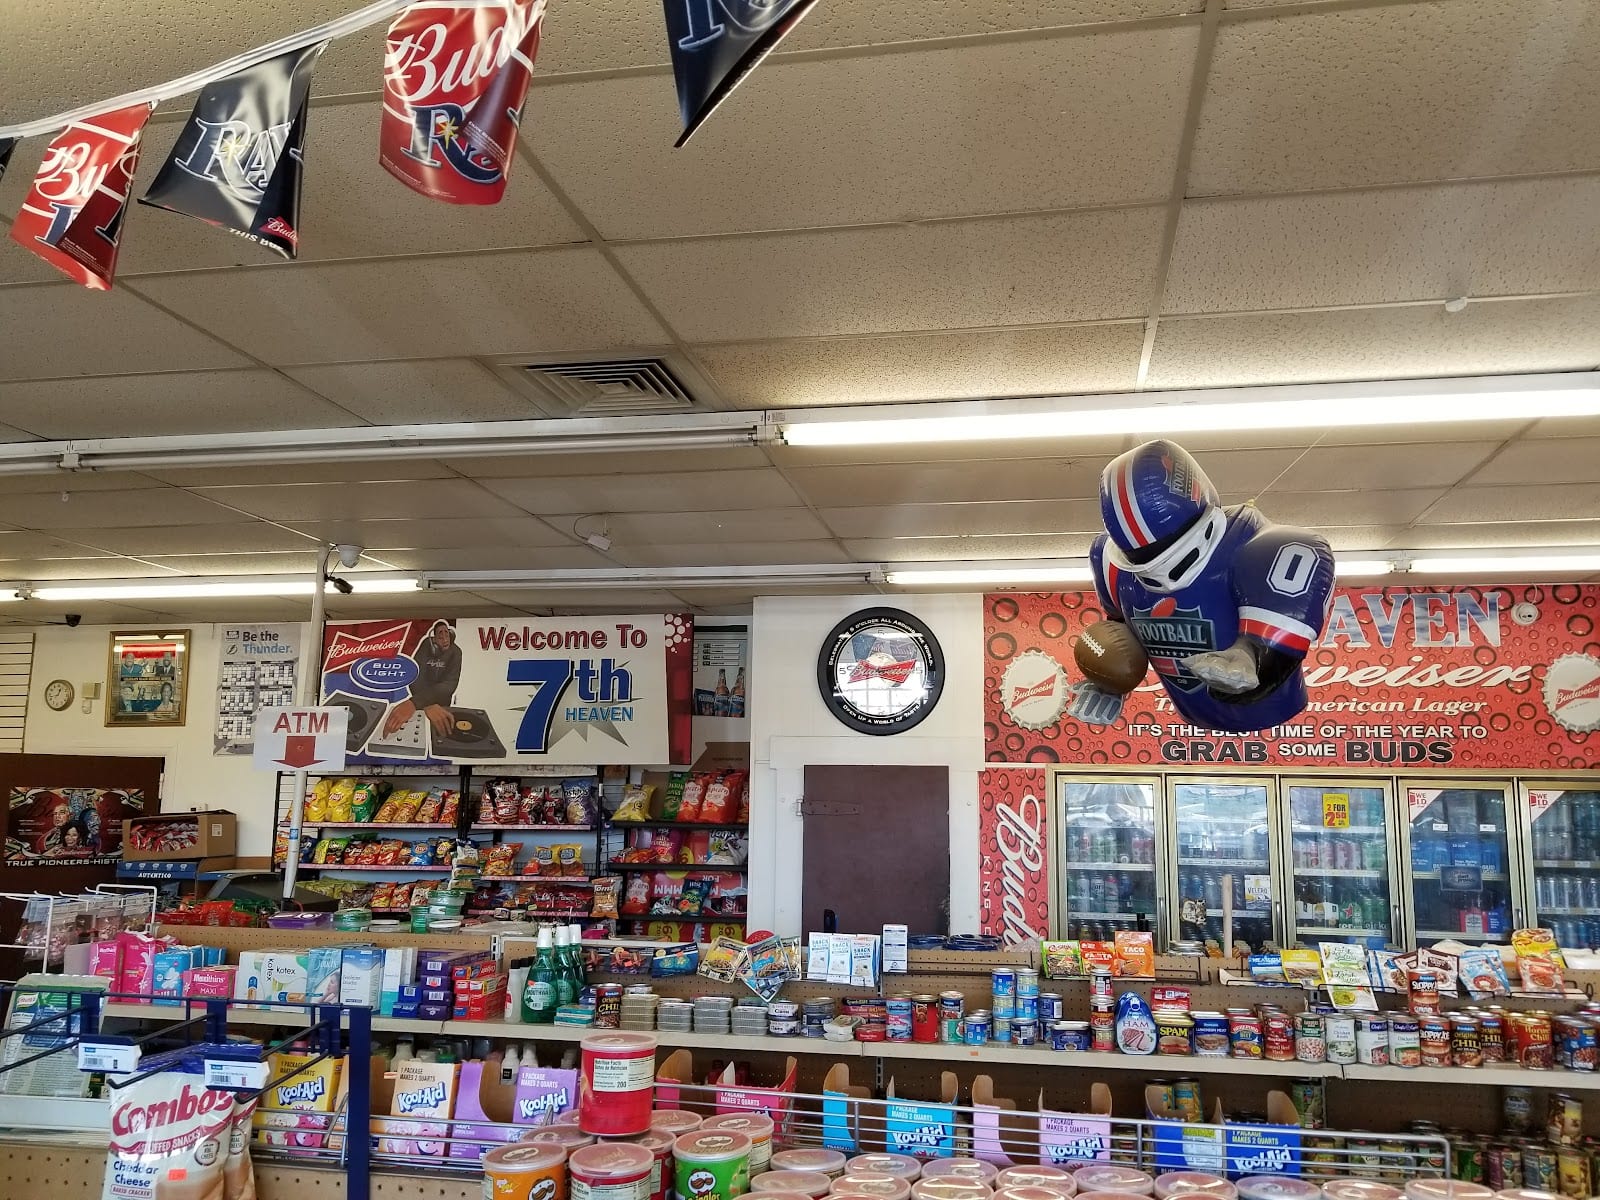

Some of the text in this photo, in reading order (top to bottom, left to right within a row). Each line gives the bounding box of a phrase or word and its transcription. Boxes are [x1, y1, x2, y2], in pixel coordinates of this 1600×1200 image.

[1312, 592, 1501, 649] AVEN
[242, 631, 257, 641] Be
[260, 630, 279, 641] the
[478, 624, 647, 651] Welcome To
[1138, 622, 1207, 644] FOOTBALL
[242, 643, 293, 654] Thunder.
[327, 639, 404, 659] Budweiser
[1301, 655, 1532, 688] weiser
[506, 659, 633, 754] 7th
[1306, 697, 1488, 715] merican Lager
[564, 706, 634, 722] HEAVEN
[272, 712, 329, 734] ATM
[1128, 724, 1163, 737] IT'S
[1167, 724, 1206, 737] THE
[1270, 725, 1314, 738] TIME
[1320, 725, 1348, 738] OF
[1352, 725, 1393, 738] THE
[1398, 725, 1454, 739] YEAR
[1460, 725, 1488, 739] TO
[1160, 740, 1454, 764] GRAB SOME BUDS
[276, 966, 296, 975] kotex
[193, 973, 226, 983] Maxithins
[1122, 1020, 1149, 1028] HAM
[1524, 1025, 1551, 1034] Horme
[1159, 1027, 1188, 1037] SPAM
[419, 1074, 436, 1082] QUARTS
[276, 1075, 325, 1106] Kool-Aid
[397, 1081, 447, 1112] Kool-Aid
[112, 1084, 233, 1137] Combos
[519, 1087, 570, 1120] Kool-Aid
[896, 1105, 918, 1113] PACKAGE
[913, 1113, 933, 1122] QUARTS
[1051, 1118, 1074, 1126] PACKAGE
[1069, 1126, 1090, 1134] QUARTS
[1257, 1137, 1279, 1145] QUARTS
[114, 1174, 151, 1187] Cheese
[128, 1188, 151, 1197] CRACKER
